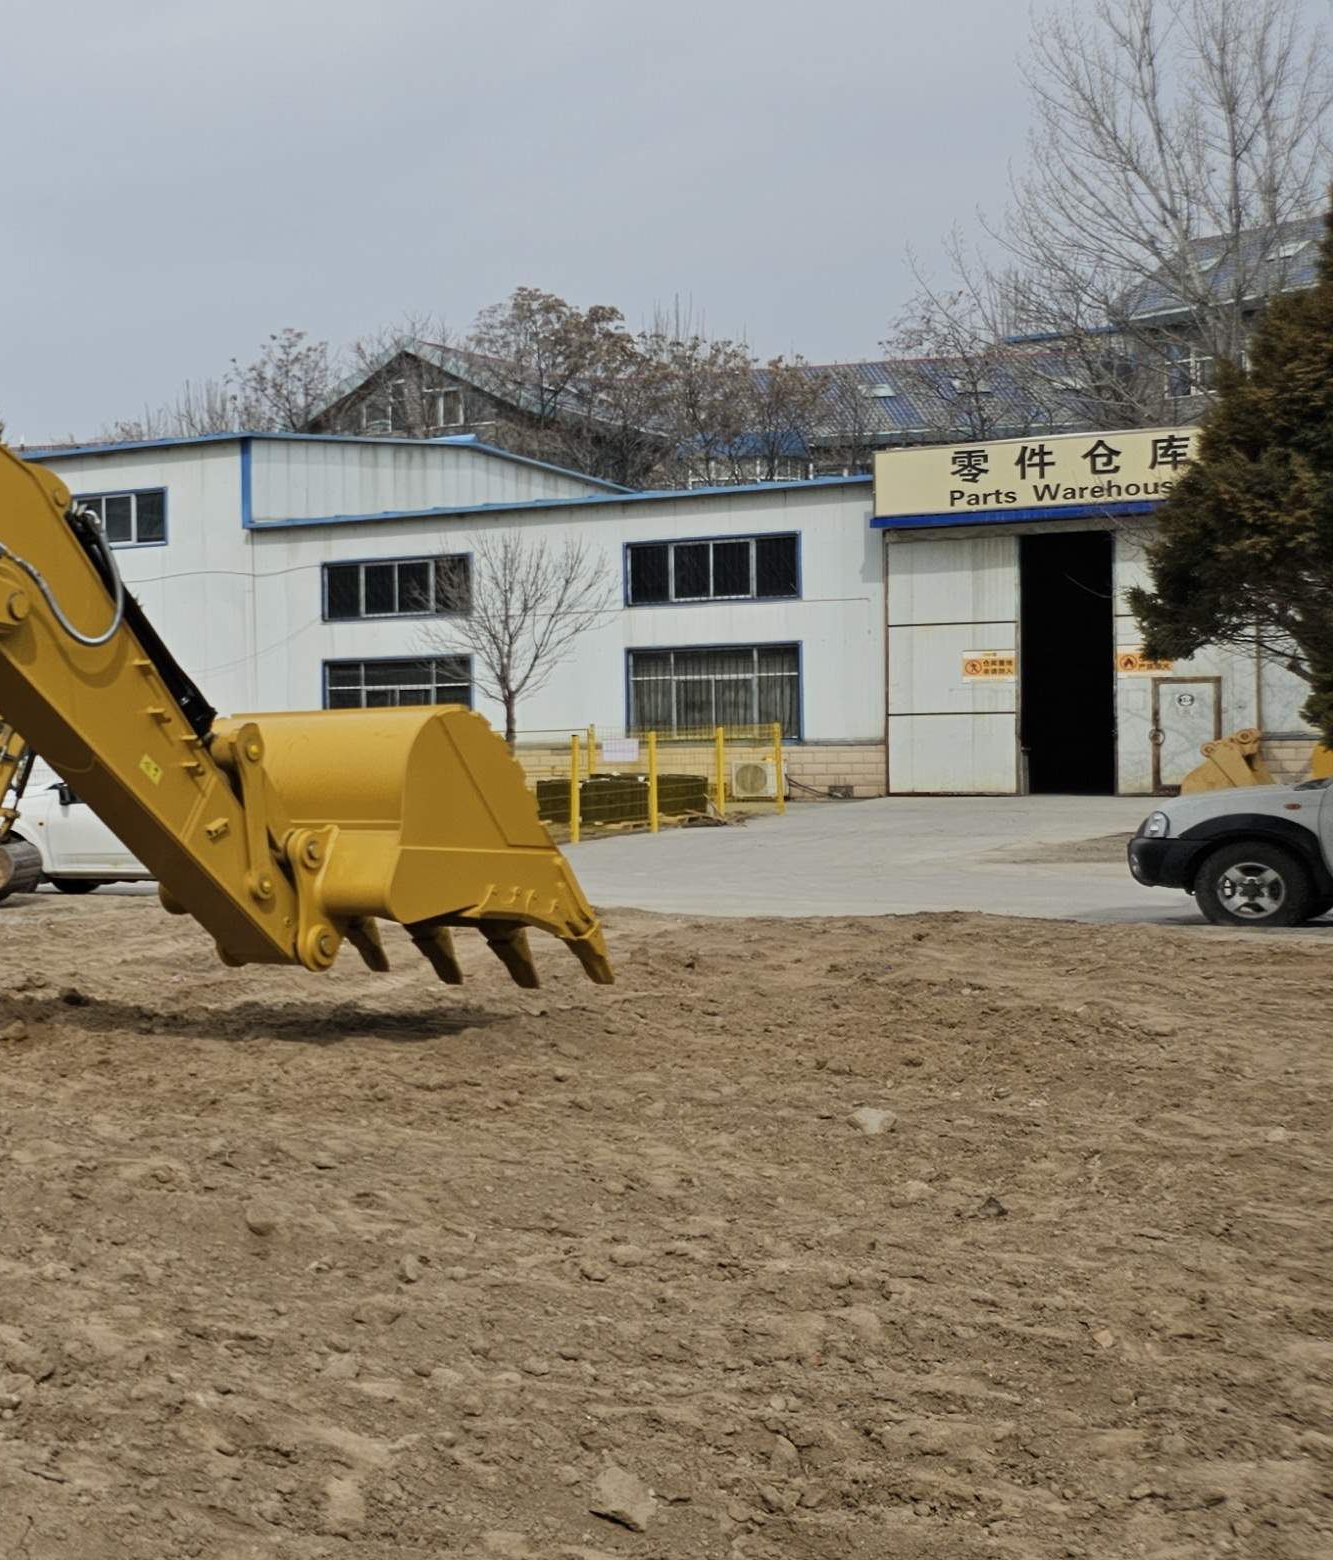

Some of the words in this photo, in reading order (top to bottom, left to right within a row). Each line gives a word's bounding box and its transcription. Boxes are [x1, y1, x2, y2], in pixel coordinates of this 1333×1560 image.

[950, 434, 1190, 484] 零件仓库
[949, 488, 1017, 507] Parts
[1032, 480, 1174, 502] Warehous
